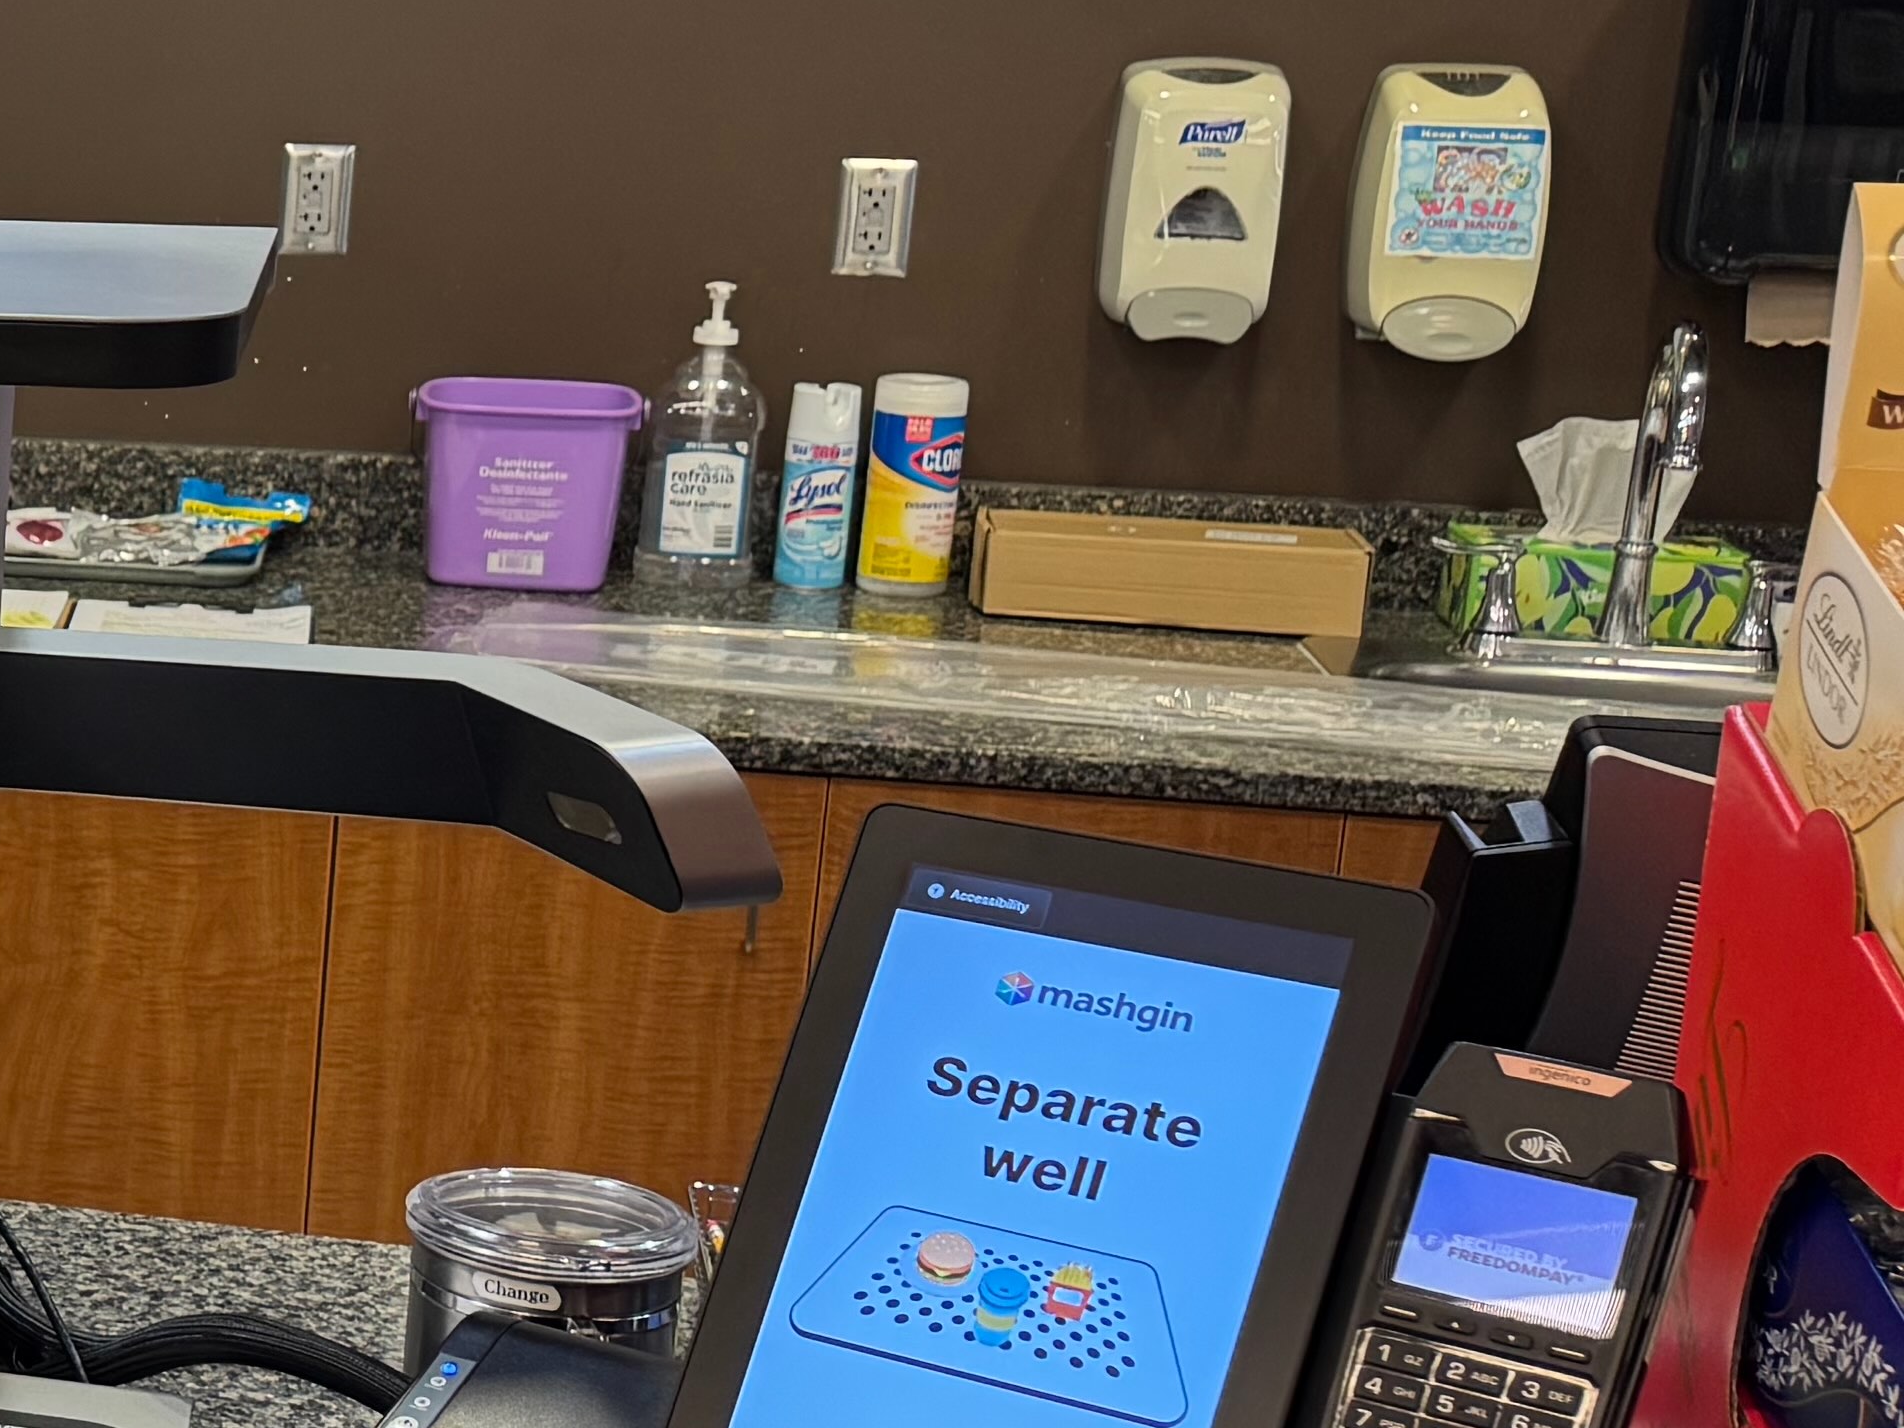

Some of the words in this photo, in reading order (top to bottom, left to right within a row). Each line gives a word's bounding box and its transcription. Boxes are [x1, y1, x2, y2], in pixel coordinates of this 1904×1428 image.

[1186, 123, 1239, 143] Purell
[1421, 194, 1516, 218] WASH
[789, 472, 847, 505] Lysol
[950, 886, 1030, 916] Accessibility
[1036, 978, 1193, 1035] mashgin
[1528, 1064, 1591, 1088] ingenico
[925, 1055, 1204, 1150] Separate
[981, 1142, 1108, 1203] well
